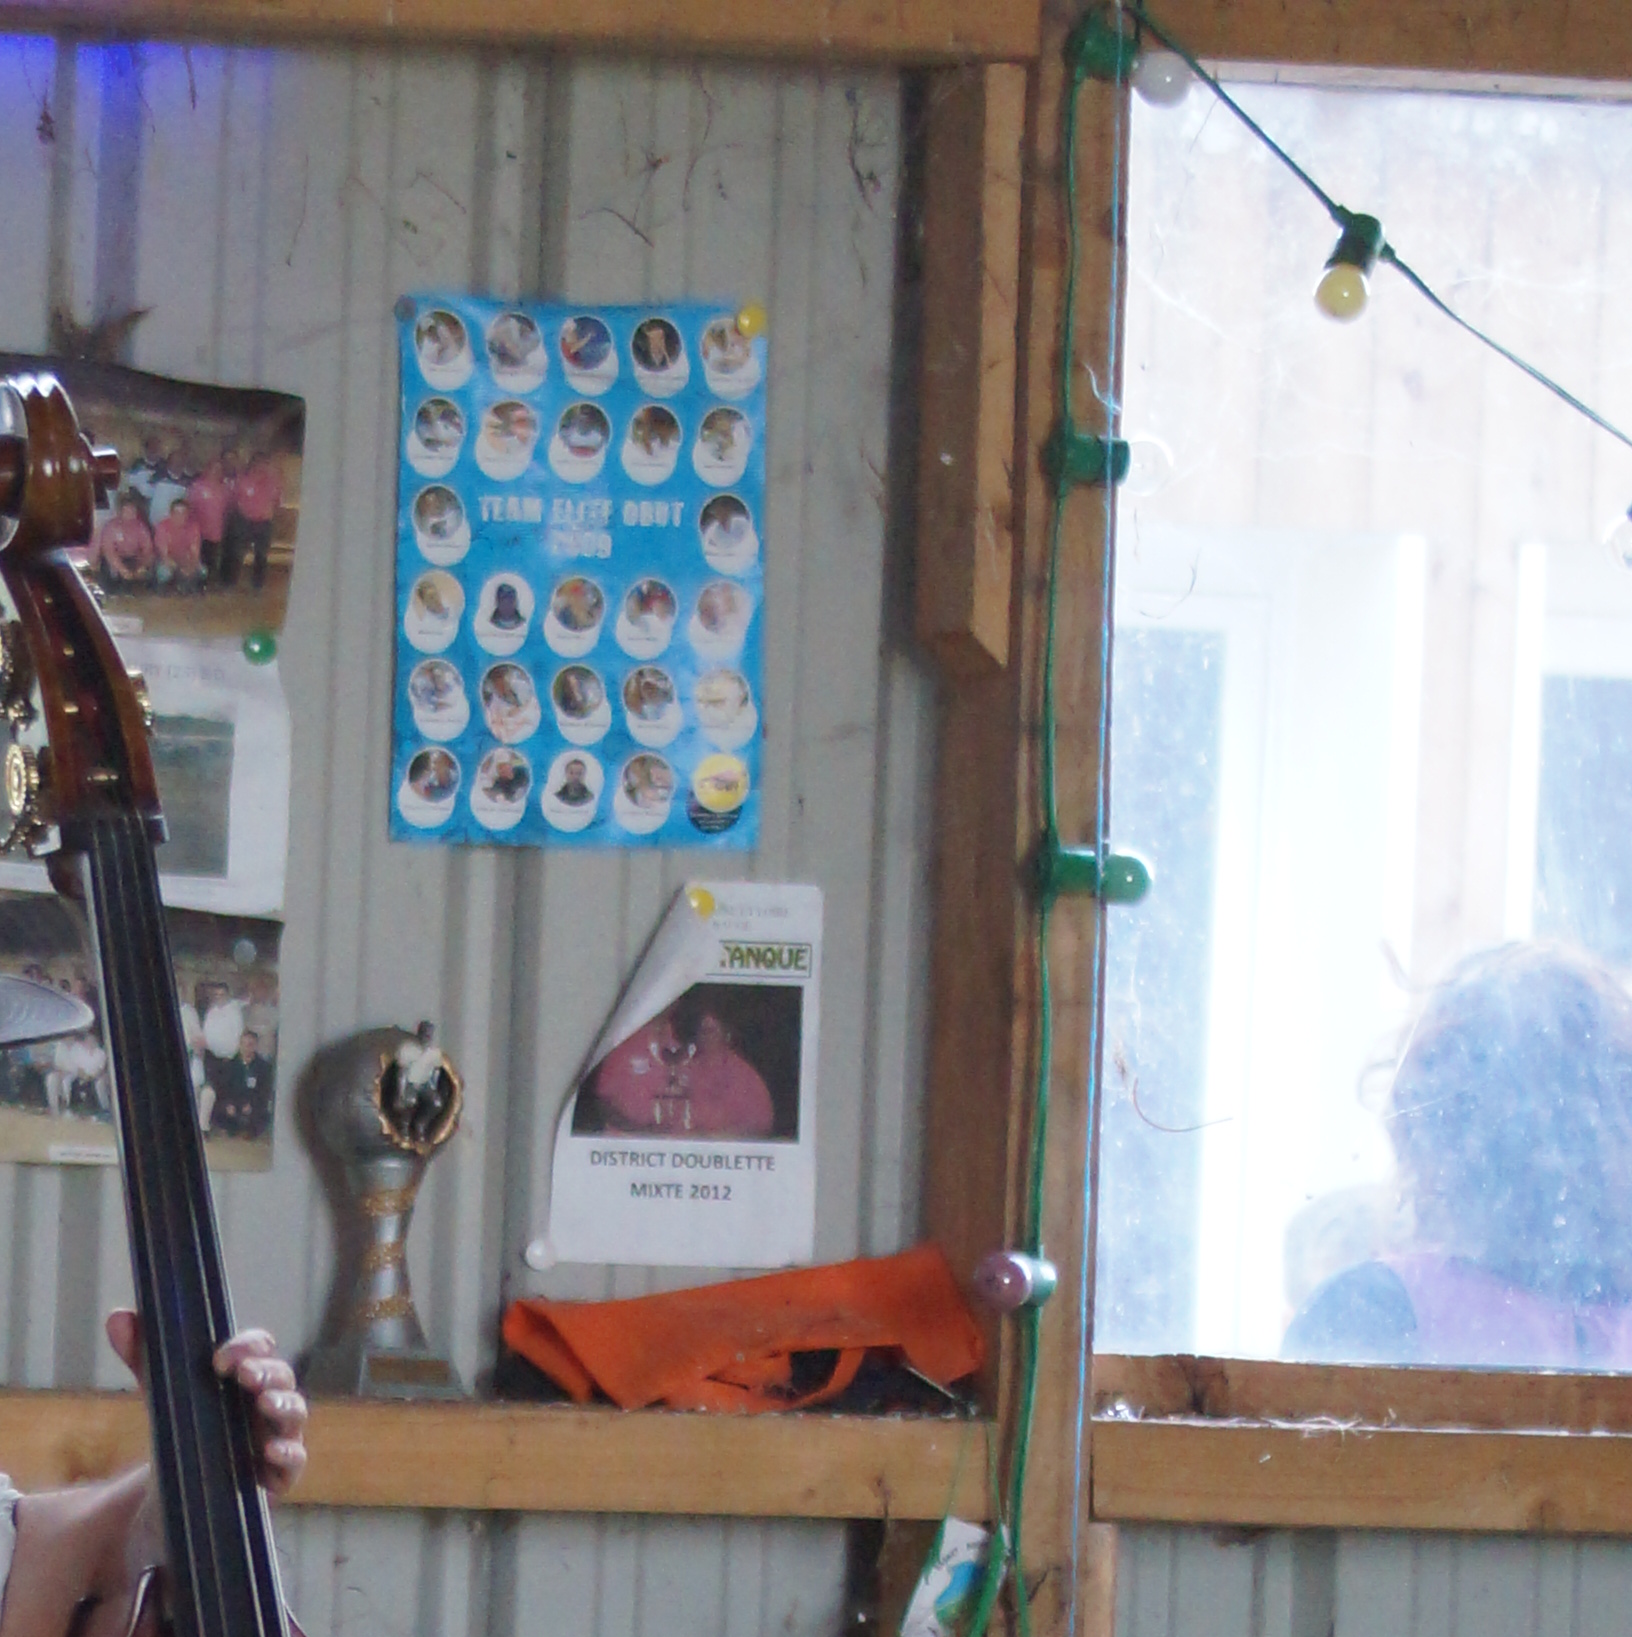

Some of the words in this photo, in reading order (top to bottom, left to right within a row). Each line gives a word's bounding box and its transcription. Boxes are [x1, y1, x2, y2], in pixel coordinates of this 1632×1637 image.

[590, 1150, 666, 1168] DISTRICT
[671, 1152, 776, 1172] DOUBLETTE
[630, 1183, 684, 1200] MIXTE
[688, 1184, 732, 1201] 2012
